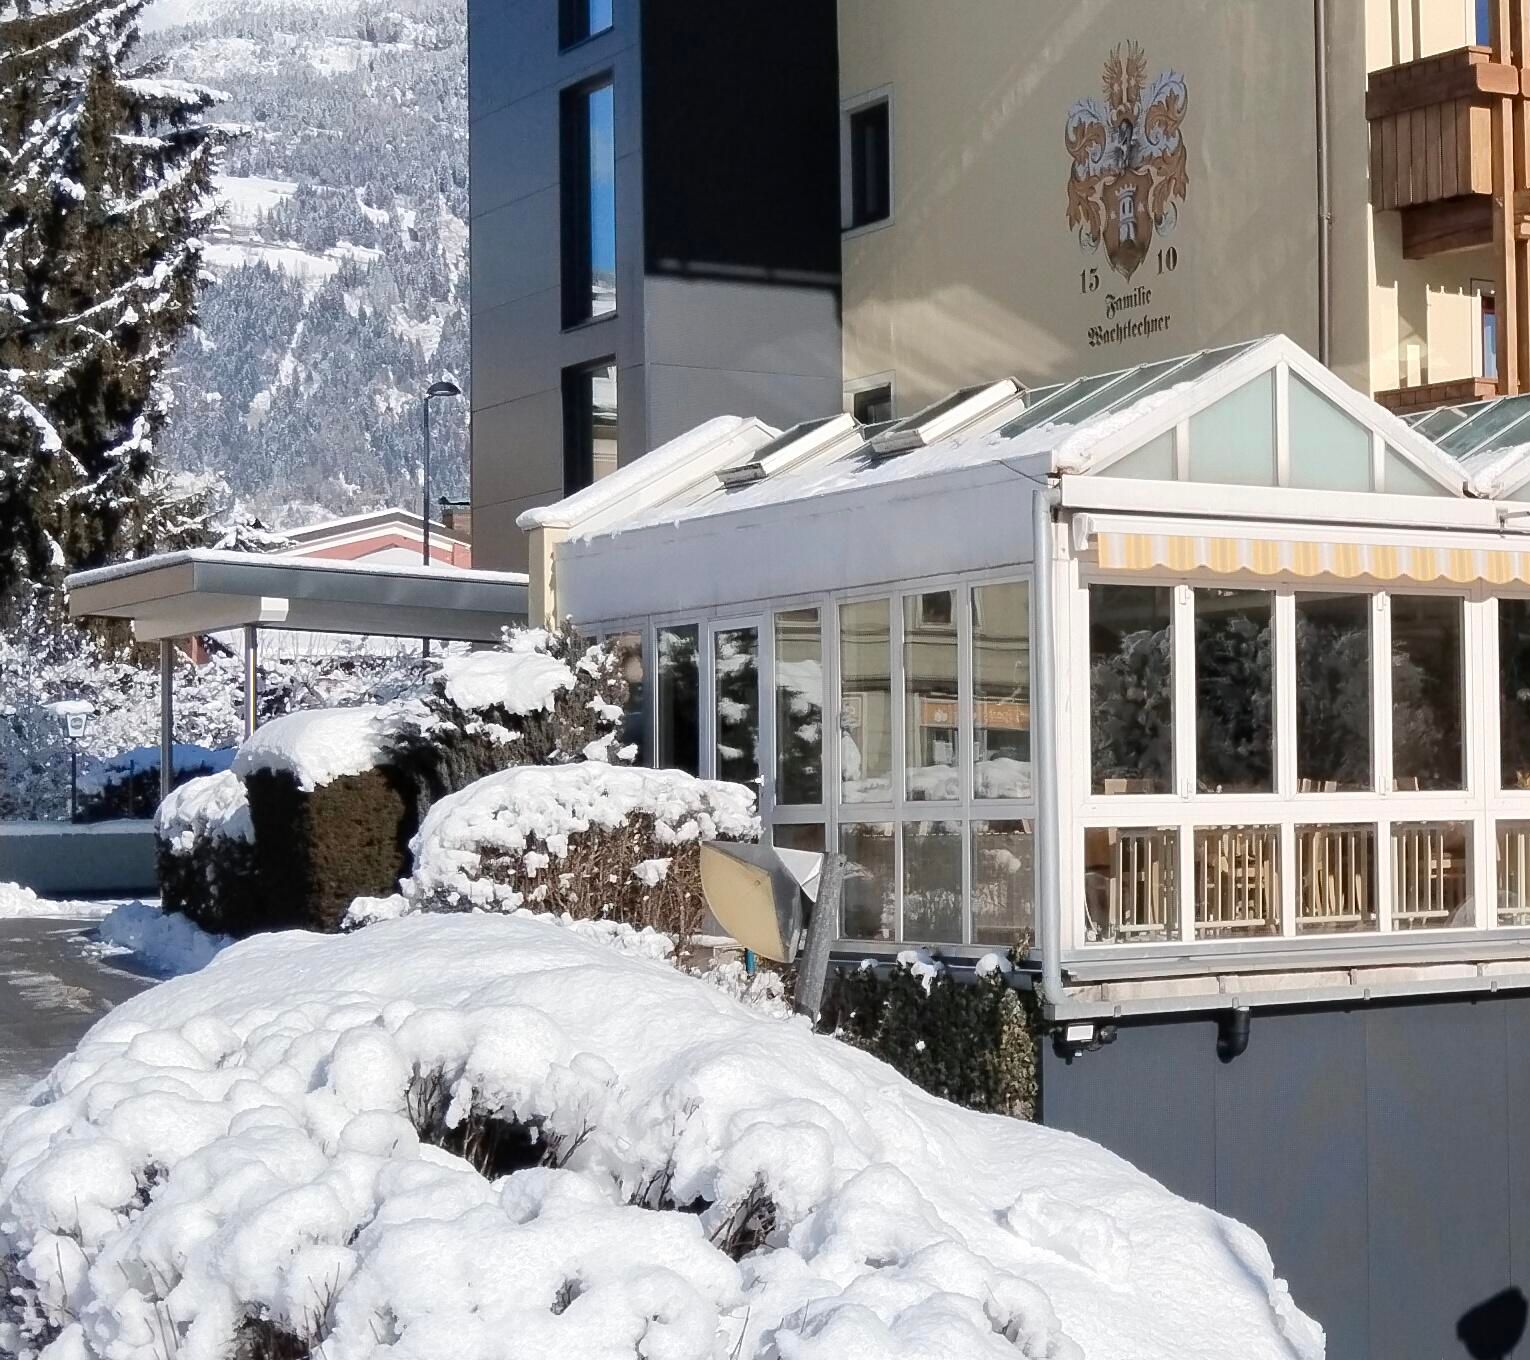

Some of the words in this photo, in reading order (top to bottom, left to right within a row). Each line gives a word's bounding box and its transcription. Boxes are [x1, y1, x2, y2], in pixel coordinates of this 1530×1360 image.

[1079, 268, 1100, 294] 15
[1157, 246, 1178, 275] 10
[1105, 285, 1152, 320] Familie
